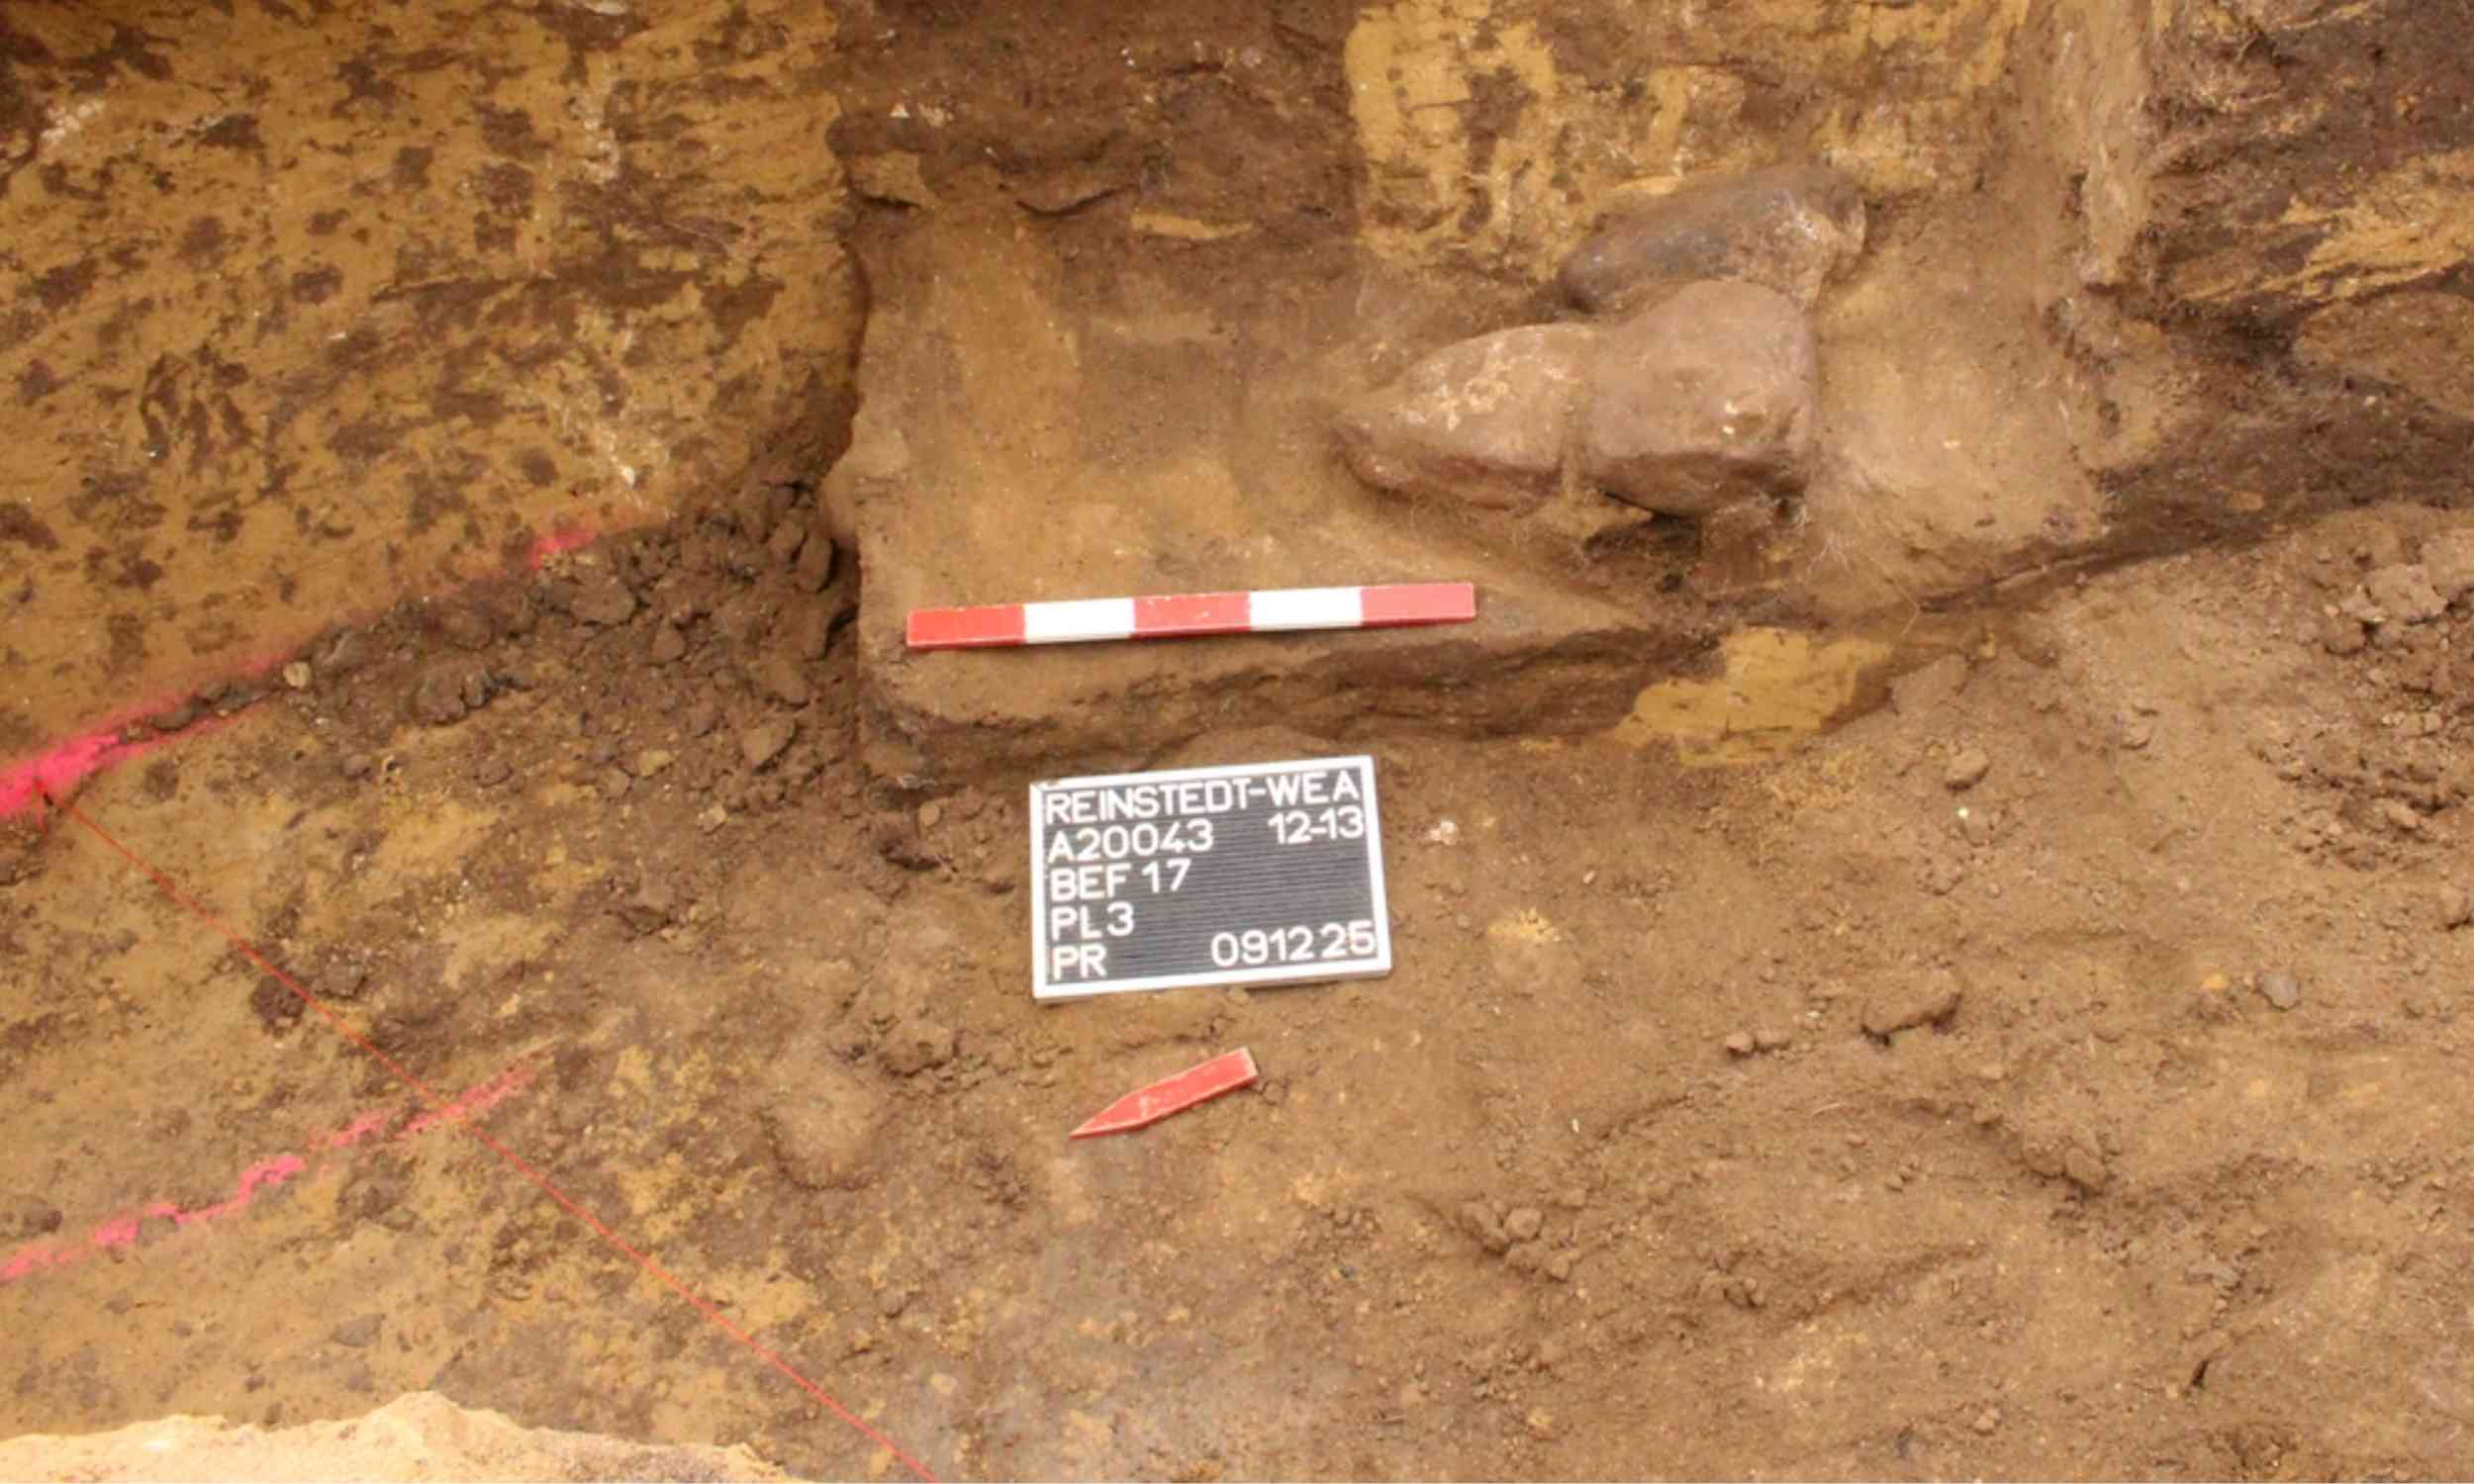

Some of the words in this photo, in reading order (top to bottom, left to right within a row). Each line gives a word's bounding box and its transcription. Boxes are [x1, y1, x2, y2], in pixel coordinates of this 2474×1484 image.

[1047, 818, 1214, 863] A20043
[1268, 805, 1364, 844] 12-13
[1050, 863, 1131, 901] BEF
[1142, 858, 1190, 892] 17
[1052, 944, 1107, 980] PR
